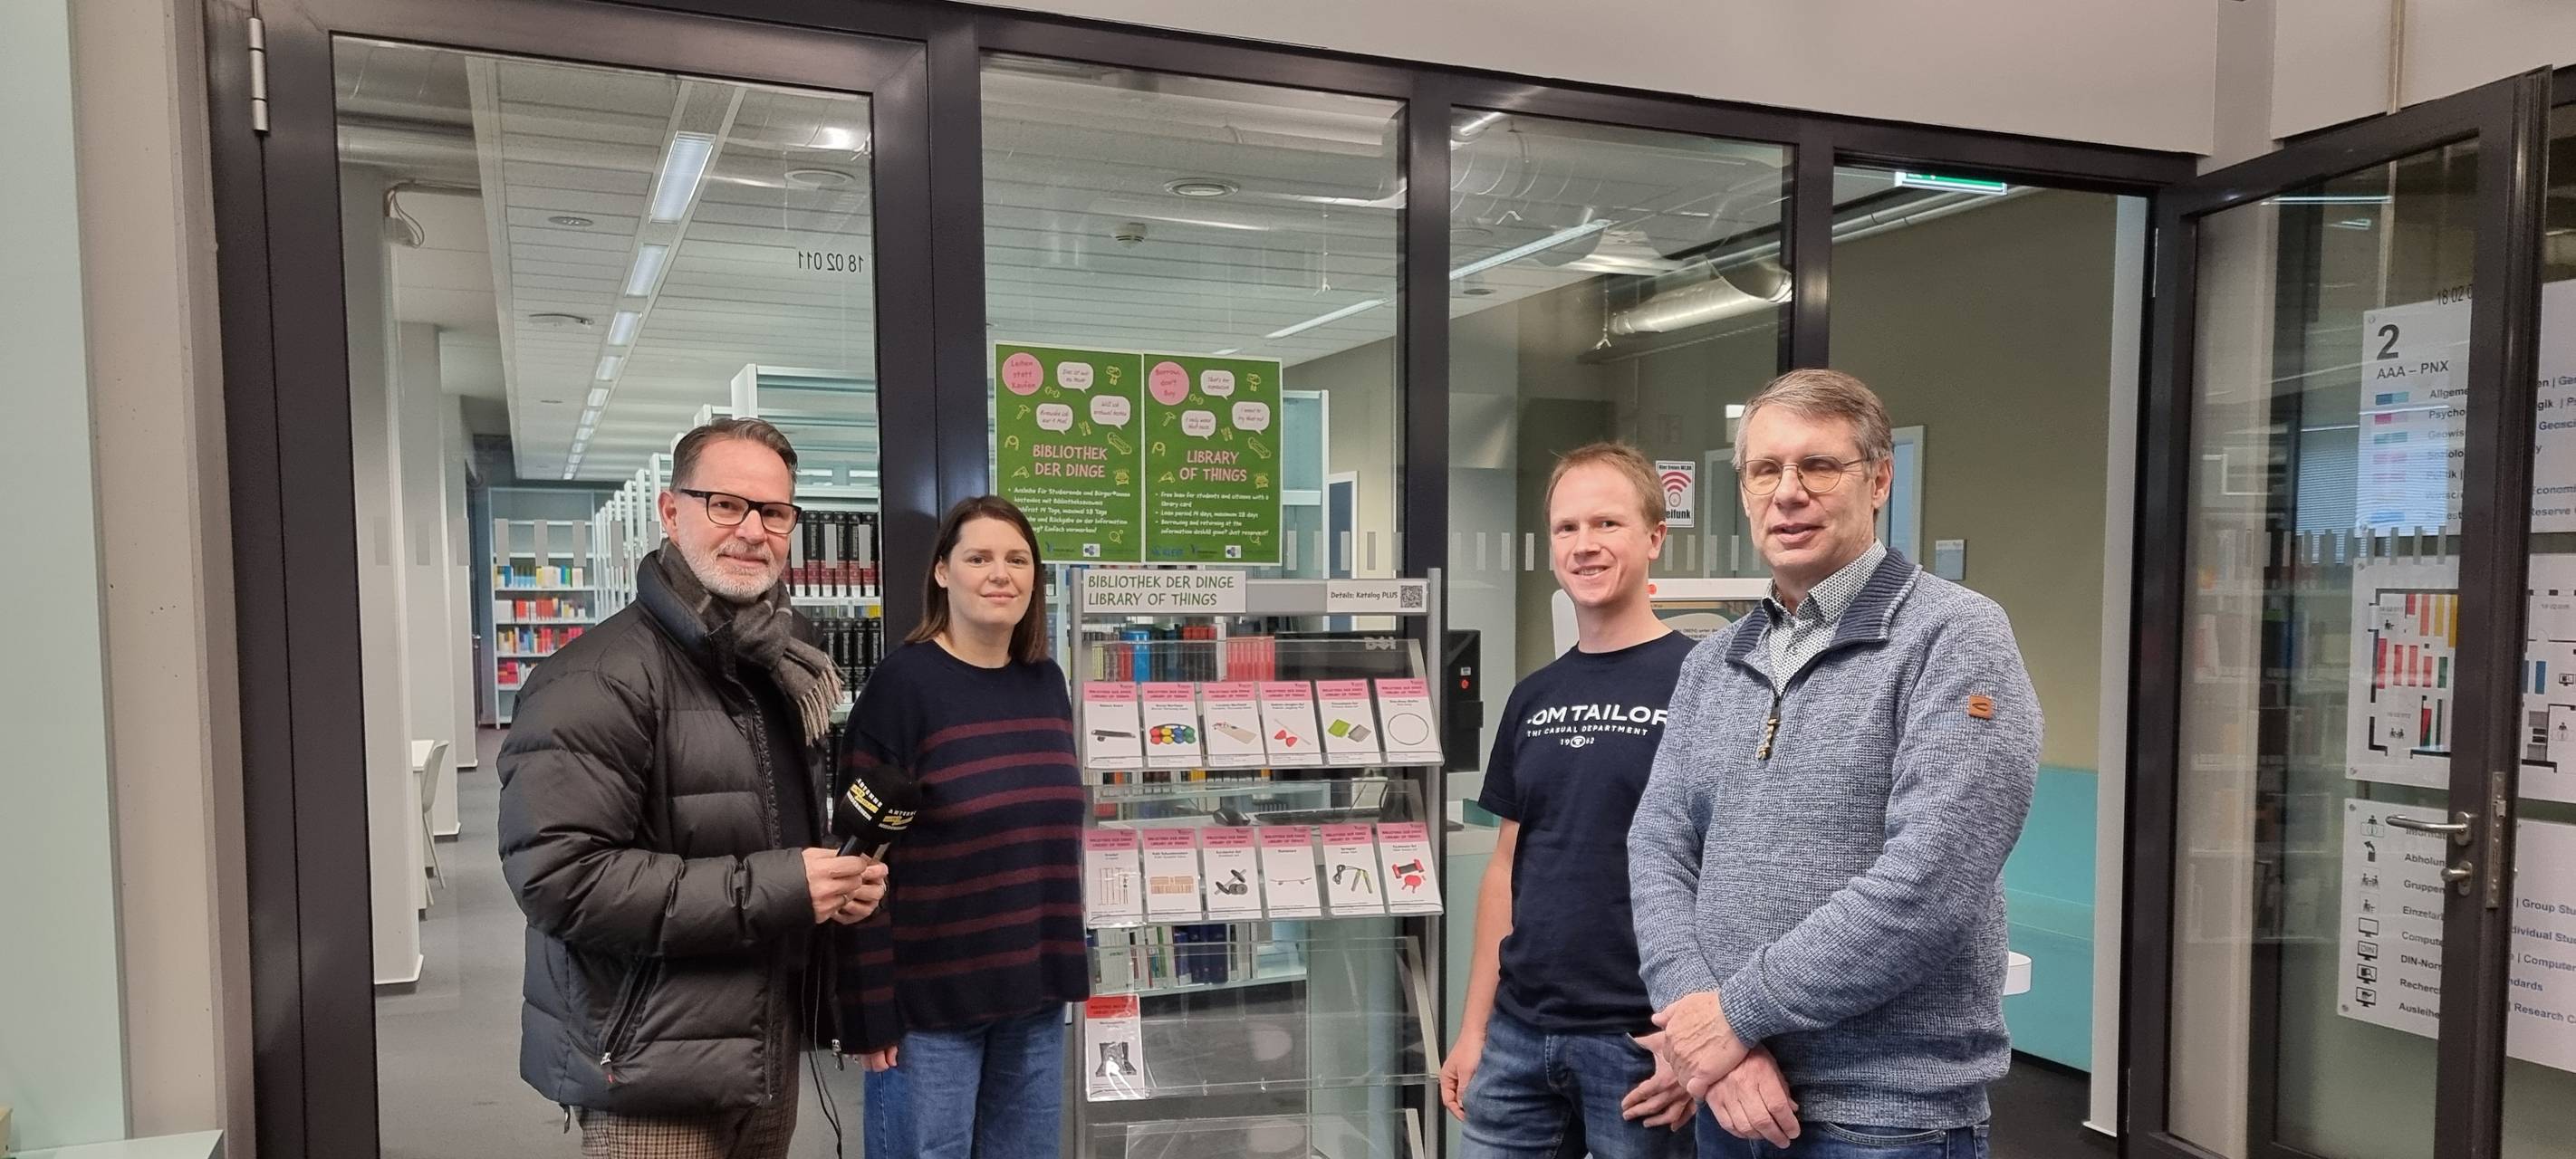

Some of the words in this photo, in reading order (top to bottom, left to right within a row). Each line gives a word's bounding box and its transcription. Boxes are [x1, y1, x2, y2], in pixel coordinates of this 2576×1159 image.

[2377, 324, 2400, 360] 2
[2377, 366, 2406, 380] AAA
[2420, 360, 2449, 375] PNX
[2429, 388, 2469, 399] Allgeme
[2429, 408, 2465, 420] Psycho
[2538, 420, 2576, 431] Geosci
[2427, 429, 2465, 438] Geowis
[1033, 444, 1109, 460] BIBLIOTHEK
[1187, 449, 1239, 465] LIBRARY
[1034, 462, 1062, 476] DER
[1065, 464, 1106, 478] DINGE
[1179, 467, 1198, 480] OF
[1203, 467, 1247, 482] THINGS
[1666, 509, 1692, 520] eifunk
[1088, 574, 1161, 589] BIBLIOTHEK
[1166, 576, 1191, 589] DER
[1196, 576, 1234, 589] DINGE
[1089, 592, 1143, 607] LIBRARY
[1147, 592, 1167, 606] OF
[1171, 592, 1217, 607] THINGS
[1356, 590, 1380, 601] Katalog
[1526, 706, 1567, 725] OM
[1543, 725, 1578, 735] CASUAL
[1581, 724, 1648, 737] DEPARTMENT
[2404, 853, 2446, 867] Abholun
[2404, 880, 2446, 894] Gruppen
[2402, 905, 2443, 920] Einzelar
[2522, 898, 2556, 913] Group
[2558, 904, 2576, 916] Stu
[2511, 925, 2552, 941] dividual
[2554, 933, 2576, 943] Stu
[2400, 978, 2440, 994] Recherc
[2509, 978, 2543, 991] ndards
[2514, 1002, 2564, 1021] Research
